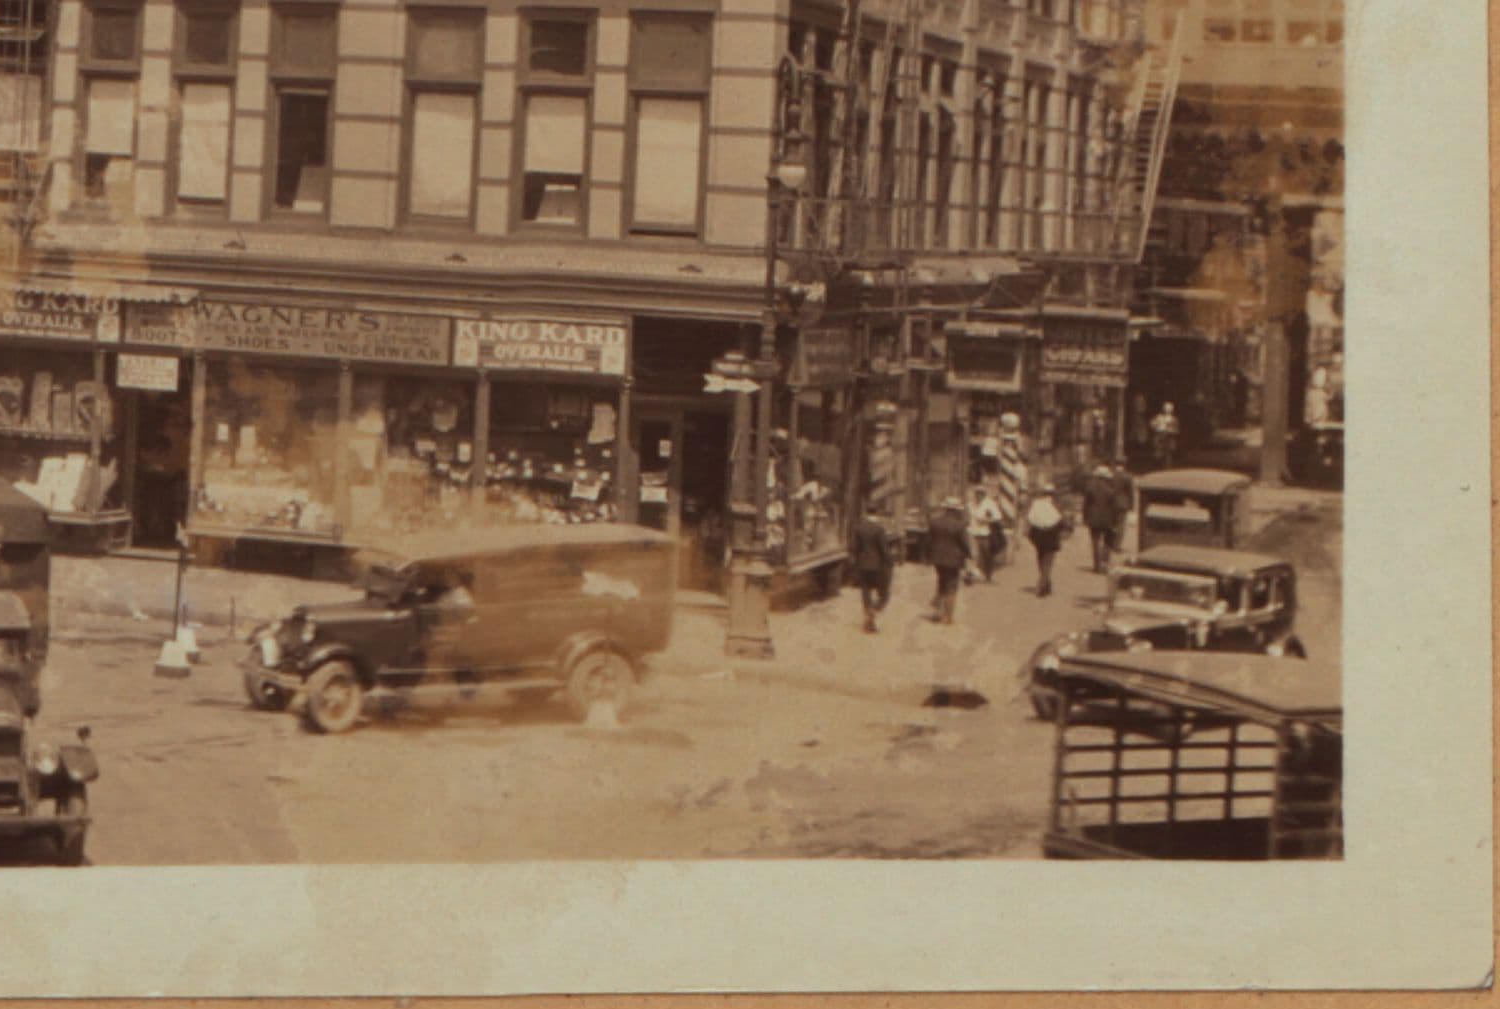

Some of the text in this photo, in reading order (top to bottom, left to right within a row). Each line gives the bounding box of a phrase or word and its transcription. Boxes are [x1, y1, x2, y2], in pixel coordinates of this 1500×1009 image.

[42, 292, 120, 315] KARD
[192, 302, 380, 329] WAGNER'S
[2, 311, 84, 330] OVERALLS
[457, 319, 531, 342] KING
[538, 322, 625, 346] KARD
[131, 326, 442, 361] BOOTS SHOES UNDERWEAR
[493, 342, 586, 363] OVERALLS
